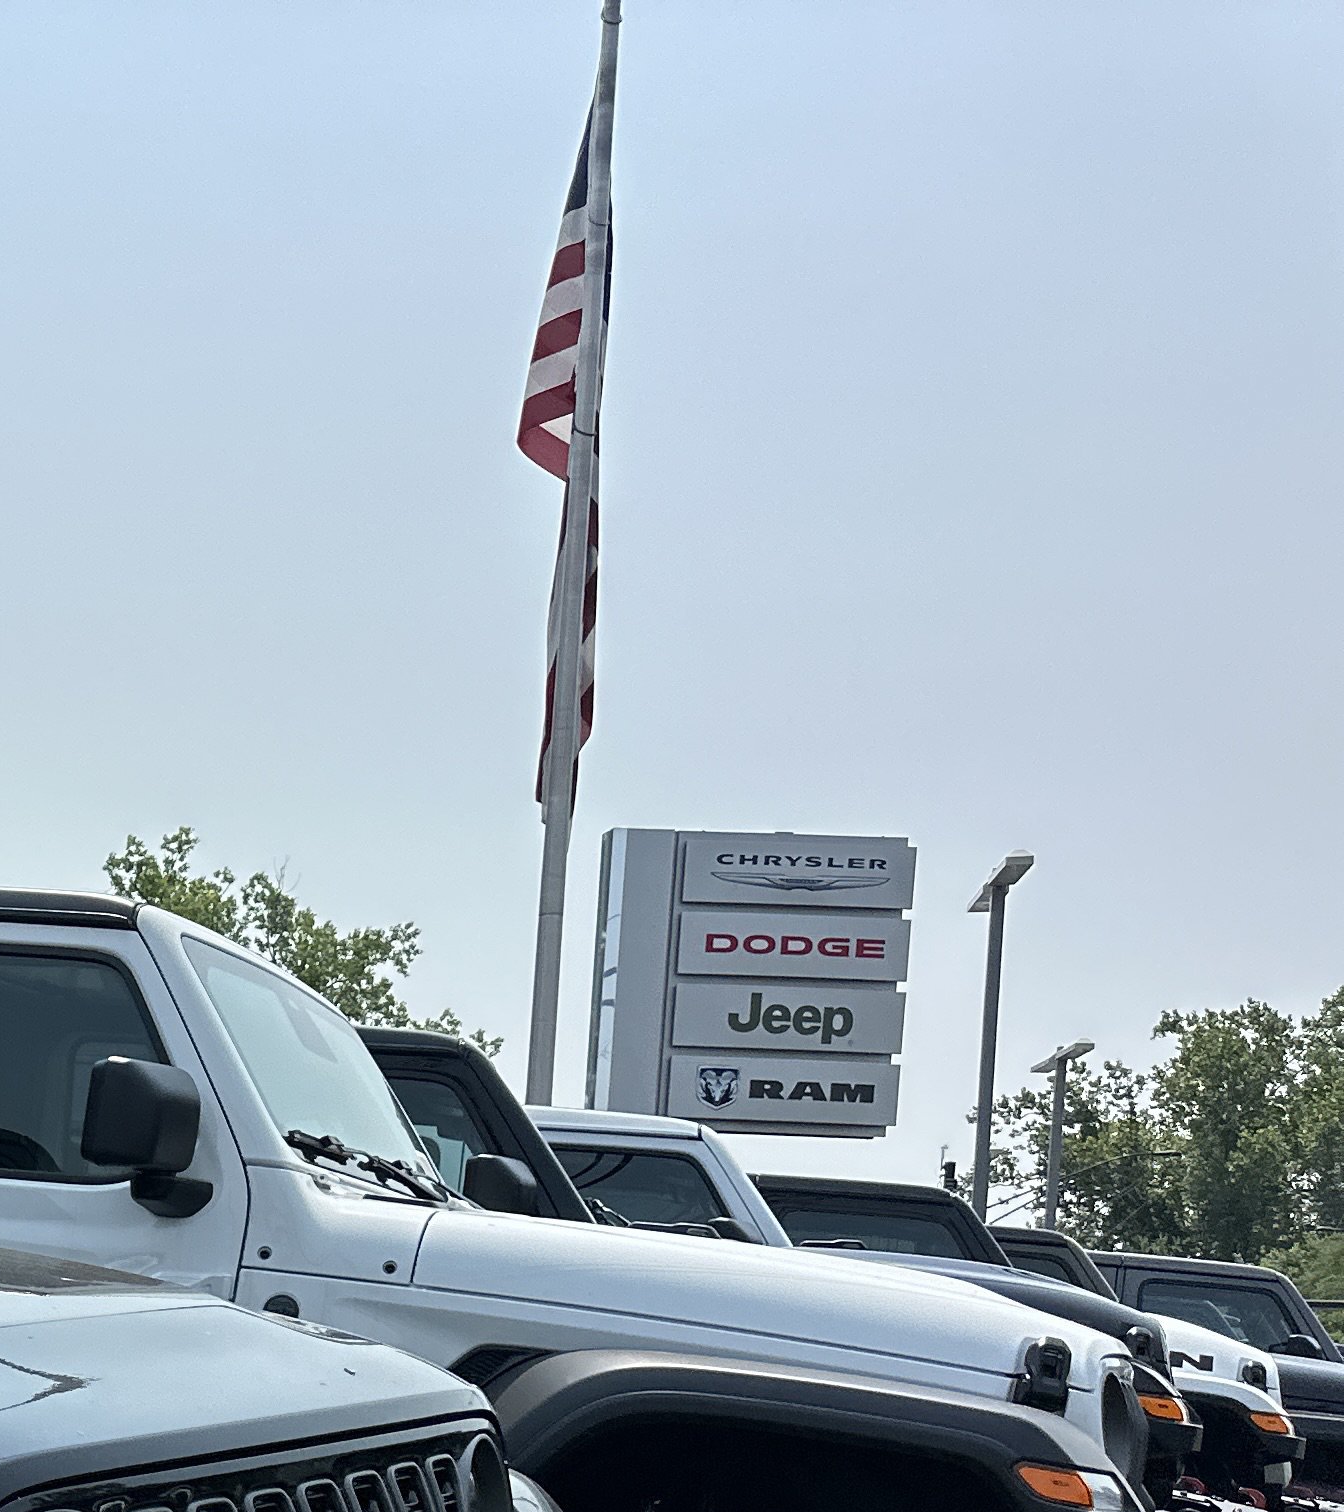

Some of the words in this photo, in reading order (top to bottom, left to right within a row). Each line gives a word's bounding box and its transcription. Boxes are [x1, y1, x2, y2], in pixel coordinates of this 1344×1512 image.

[716, 853, 887, 871] CHRYSLER
[704, 933, 886, 959] DODGE
[727, 992, 854, 1045] Jeep
[748, 1079, 876, 1104] RAM
